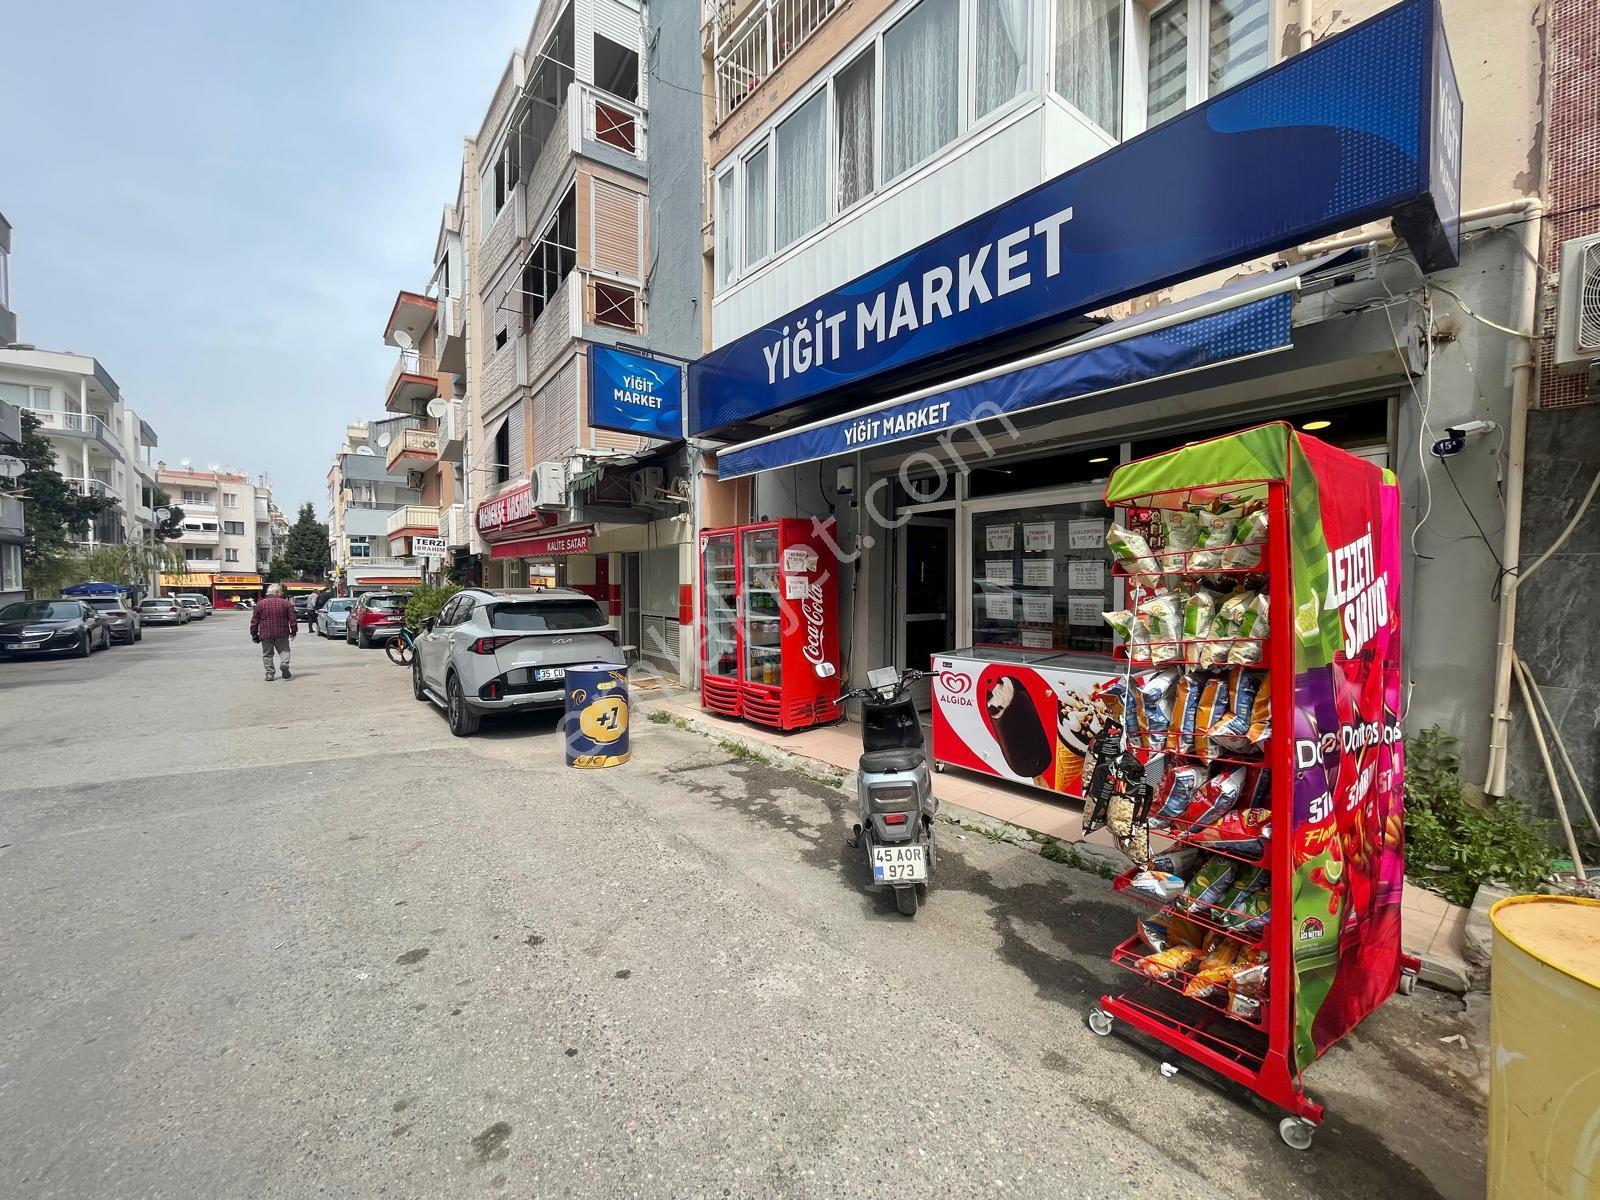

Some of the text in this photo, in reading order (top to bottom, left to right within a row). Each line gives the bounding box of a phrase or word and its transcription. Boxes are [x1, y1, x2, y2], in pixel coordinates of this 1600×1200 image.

[762, 206, 1073, 385] YİĞİT MARKET
[623, 374, 654, 393] YİĞİT
[614, 388, 663, 409] MARKET
[844, 401, 951, 446] YİĞİT MARKET
[547, 537, 587, 551] KALİTE SATAR
[541, 669, 551, 678] 35
[876, 848, 921, 862] 45 AOR
[889, 864, 915, 877] 973
